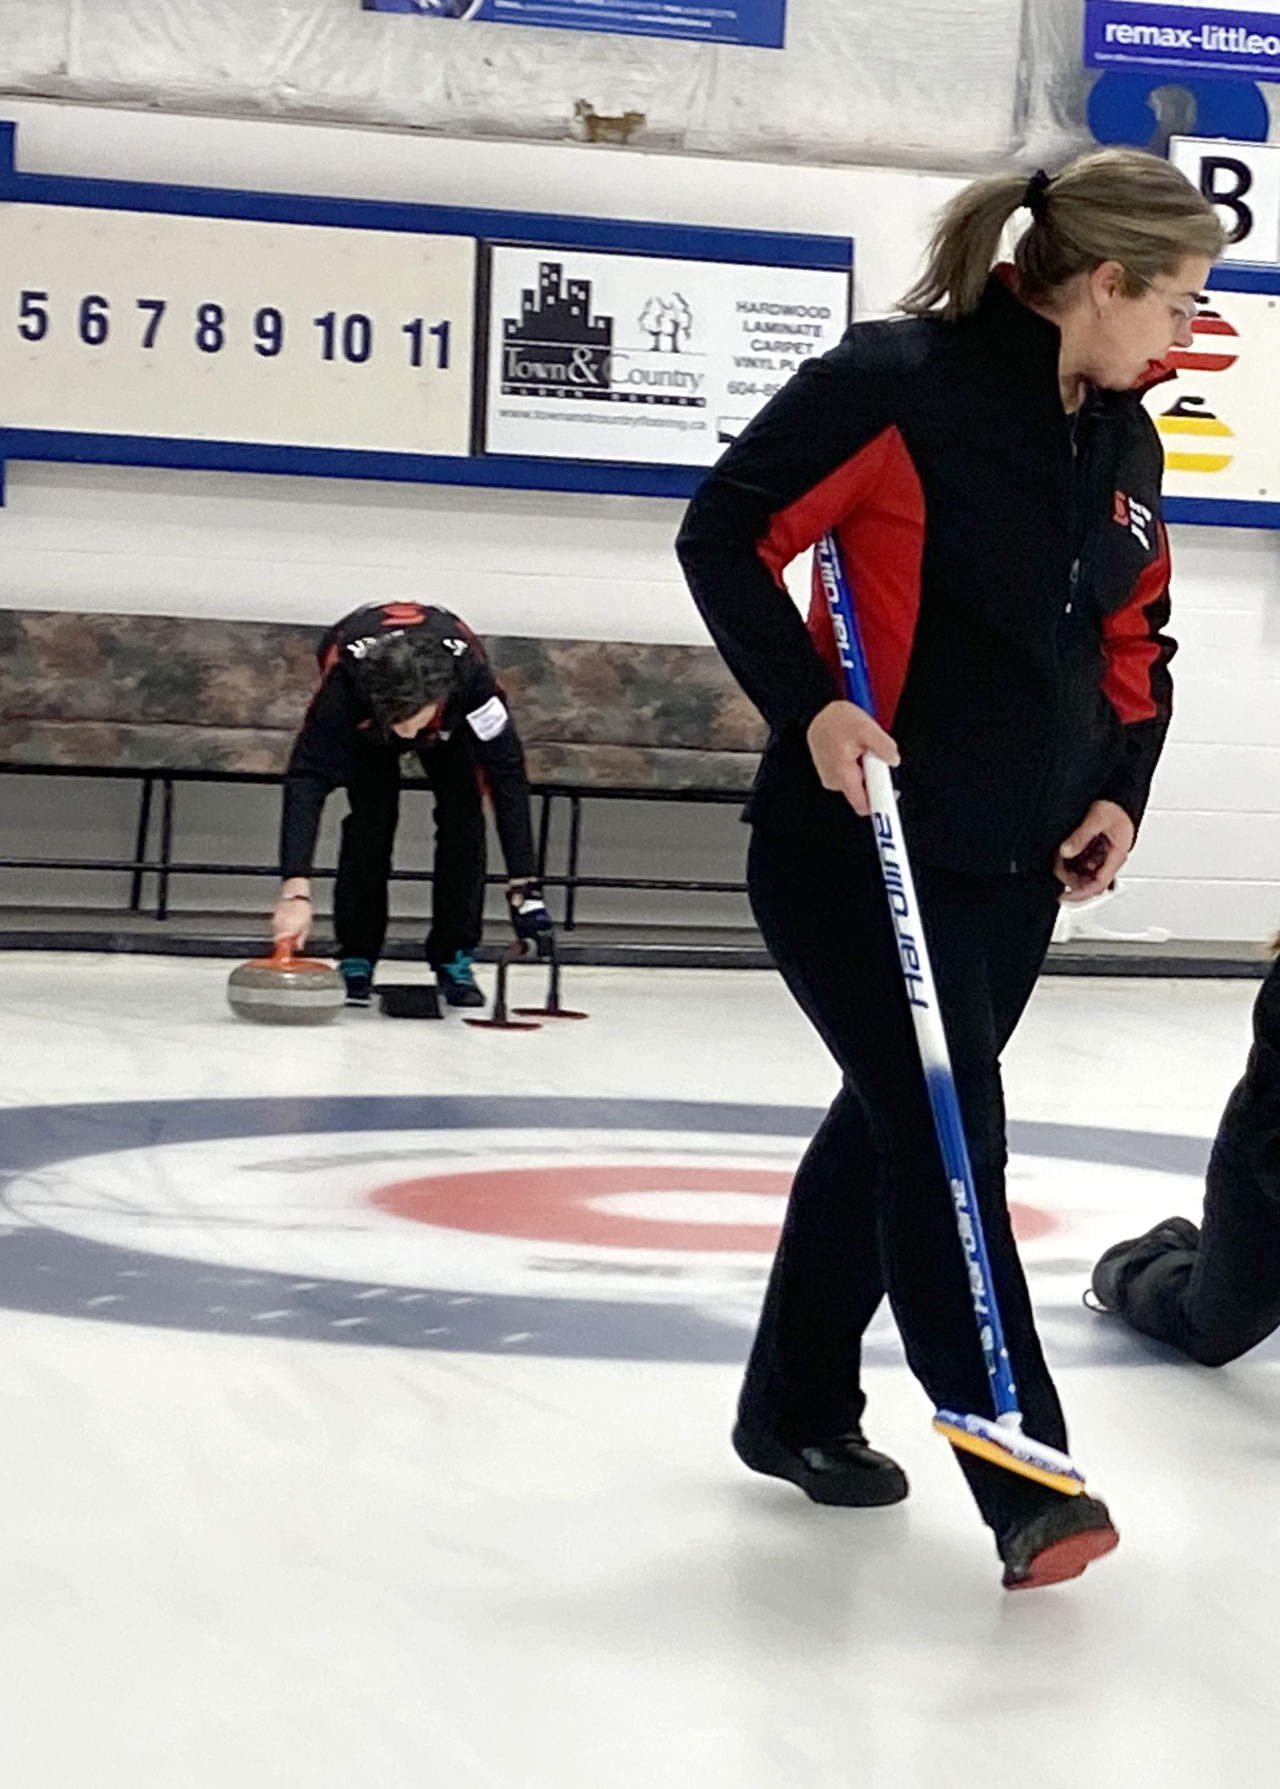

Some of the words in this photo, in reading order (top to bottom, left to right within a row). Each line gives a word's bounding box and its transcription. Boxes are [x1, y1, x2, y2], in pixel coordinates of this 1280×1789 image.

[1200, 156, 1253, 244] B
[18, 290, 49, 341] 5
[79, 295, 110, 345] 6
[136, 299, 166, 348] 7
[195, 303, 225, 353] 8
[254, 307, 283, 357] 9
[314, 312, 372, 363] 10
[402, 318, 450, 369] 11
[736, 301, 832, 320] HARDWOOD
[750, 338, 815, 355] CARPET
[872, 811, 930, 1010] Hardline
